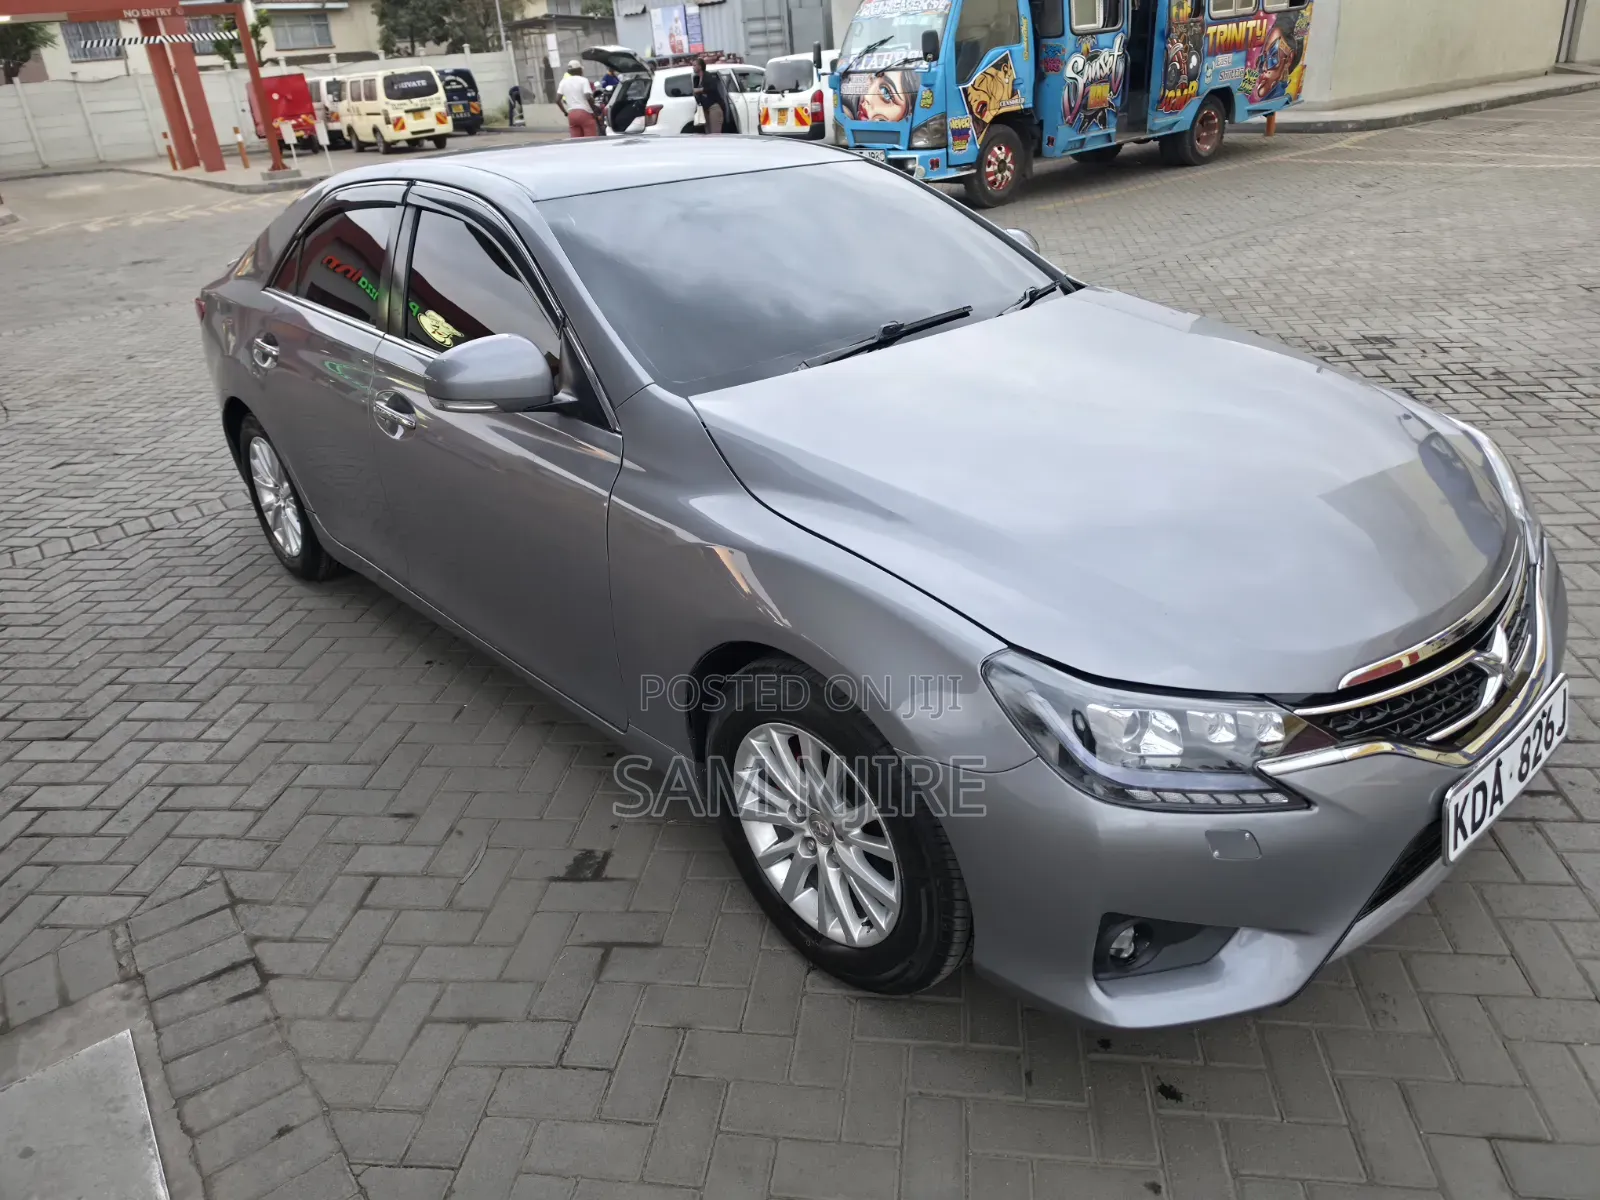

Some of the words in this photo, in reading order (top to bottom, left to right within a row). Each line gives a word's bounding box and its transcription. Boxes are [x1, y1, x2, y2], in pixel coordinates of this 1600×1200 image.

[122, 9, 140, 18] NO
[141, 7, 172, 17] ENTRY
[1207, 18, 1268, 53] TRINITY
[1453, 763, 1504, 851] KDA
[1517, 687, 1567, 783] 826J
